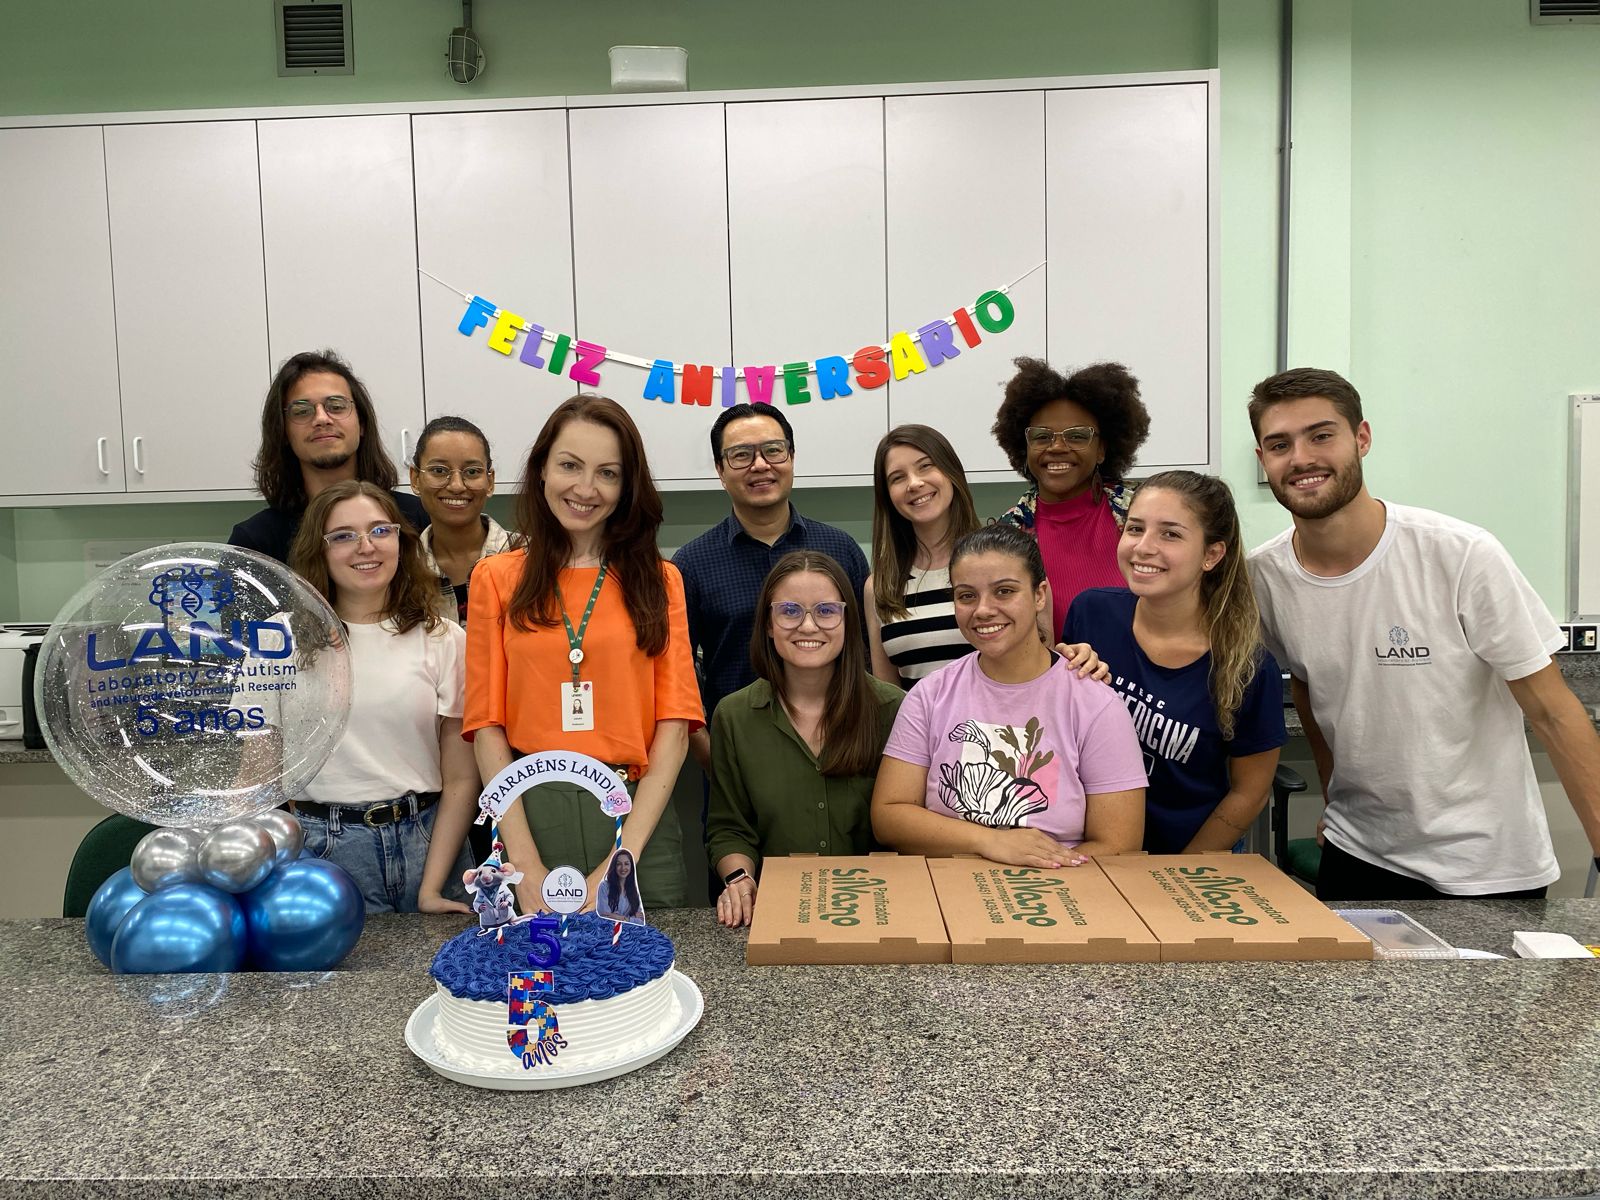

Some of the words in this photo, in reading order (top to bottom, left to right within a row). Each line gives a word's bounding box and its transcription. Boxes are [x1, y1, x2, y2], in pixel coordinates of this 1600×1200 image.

[458, 295, 607, 387] FELIZ
[643, 290, 1015, 407] ANIVERSARIO
[86, 619, 294, 672] LAND
[1375, 647, 1430, 658] LAND
[88, 668, 199, 693] Laboratory
[235, 664, 297, 676] Autism
[91, 696, 110, 708] and
[113, 684, 244, 706] Neurodevelopmental
[249, 681, 297, 692] Research
[136, 706, 159, 736] 5
[173, 706, 265, 733] anos
[1118, 691, 1200, 764] DICINA
[490, 758, 567, 804] PARABÉNS
[570, 760, 616, 794] LAND!
[547, 889, 583, 897] LAND
[873, 887, 890, 926] Panificadora
[1055, 887, 1088, 926] Panificadora
[1238, 885, 1290, 924] Panificadora
[527, 917, 561, 968] 5
[506, 970, 560, 1061] 5
[522, 1031, 568, 1071] anos
